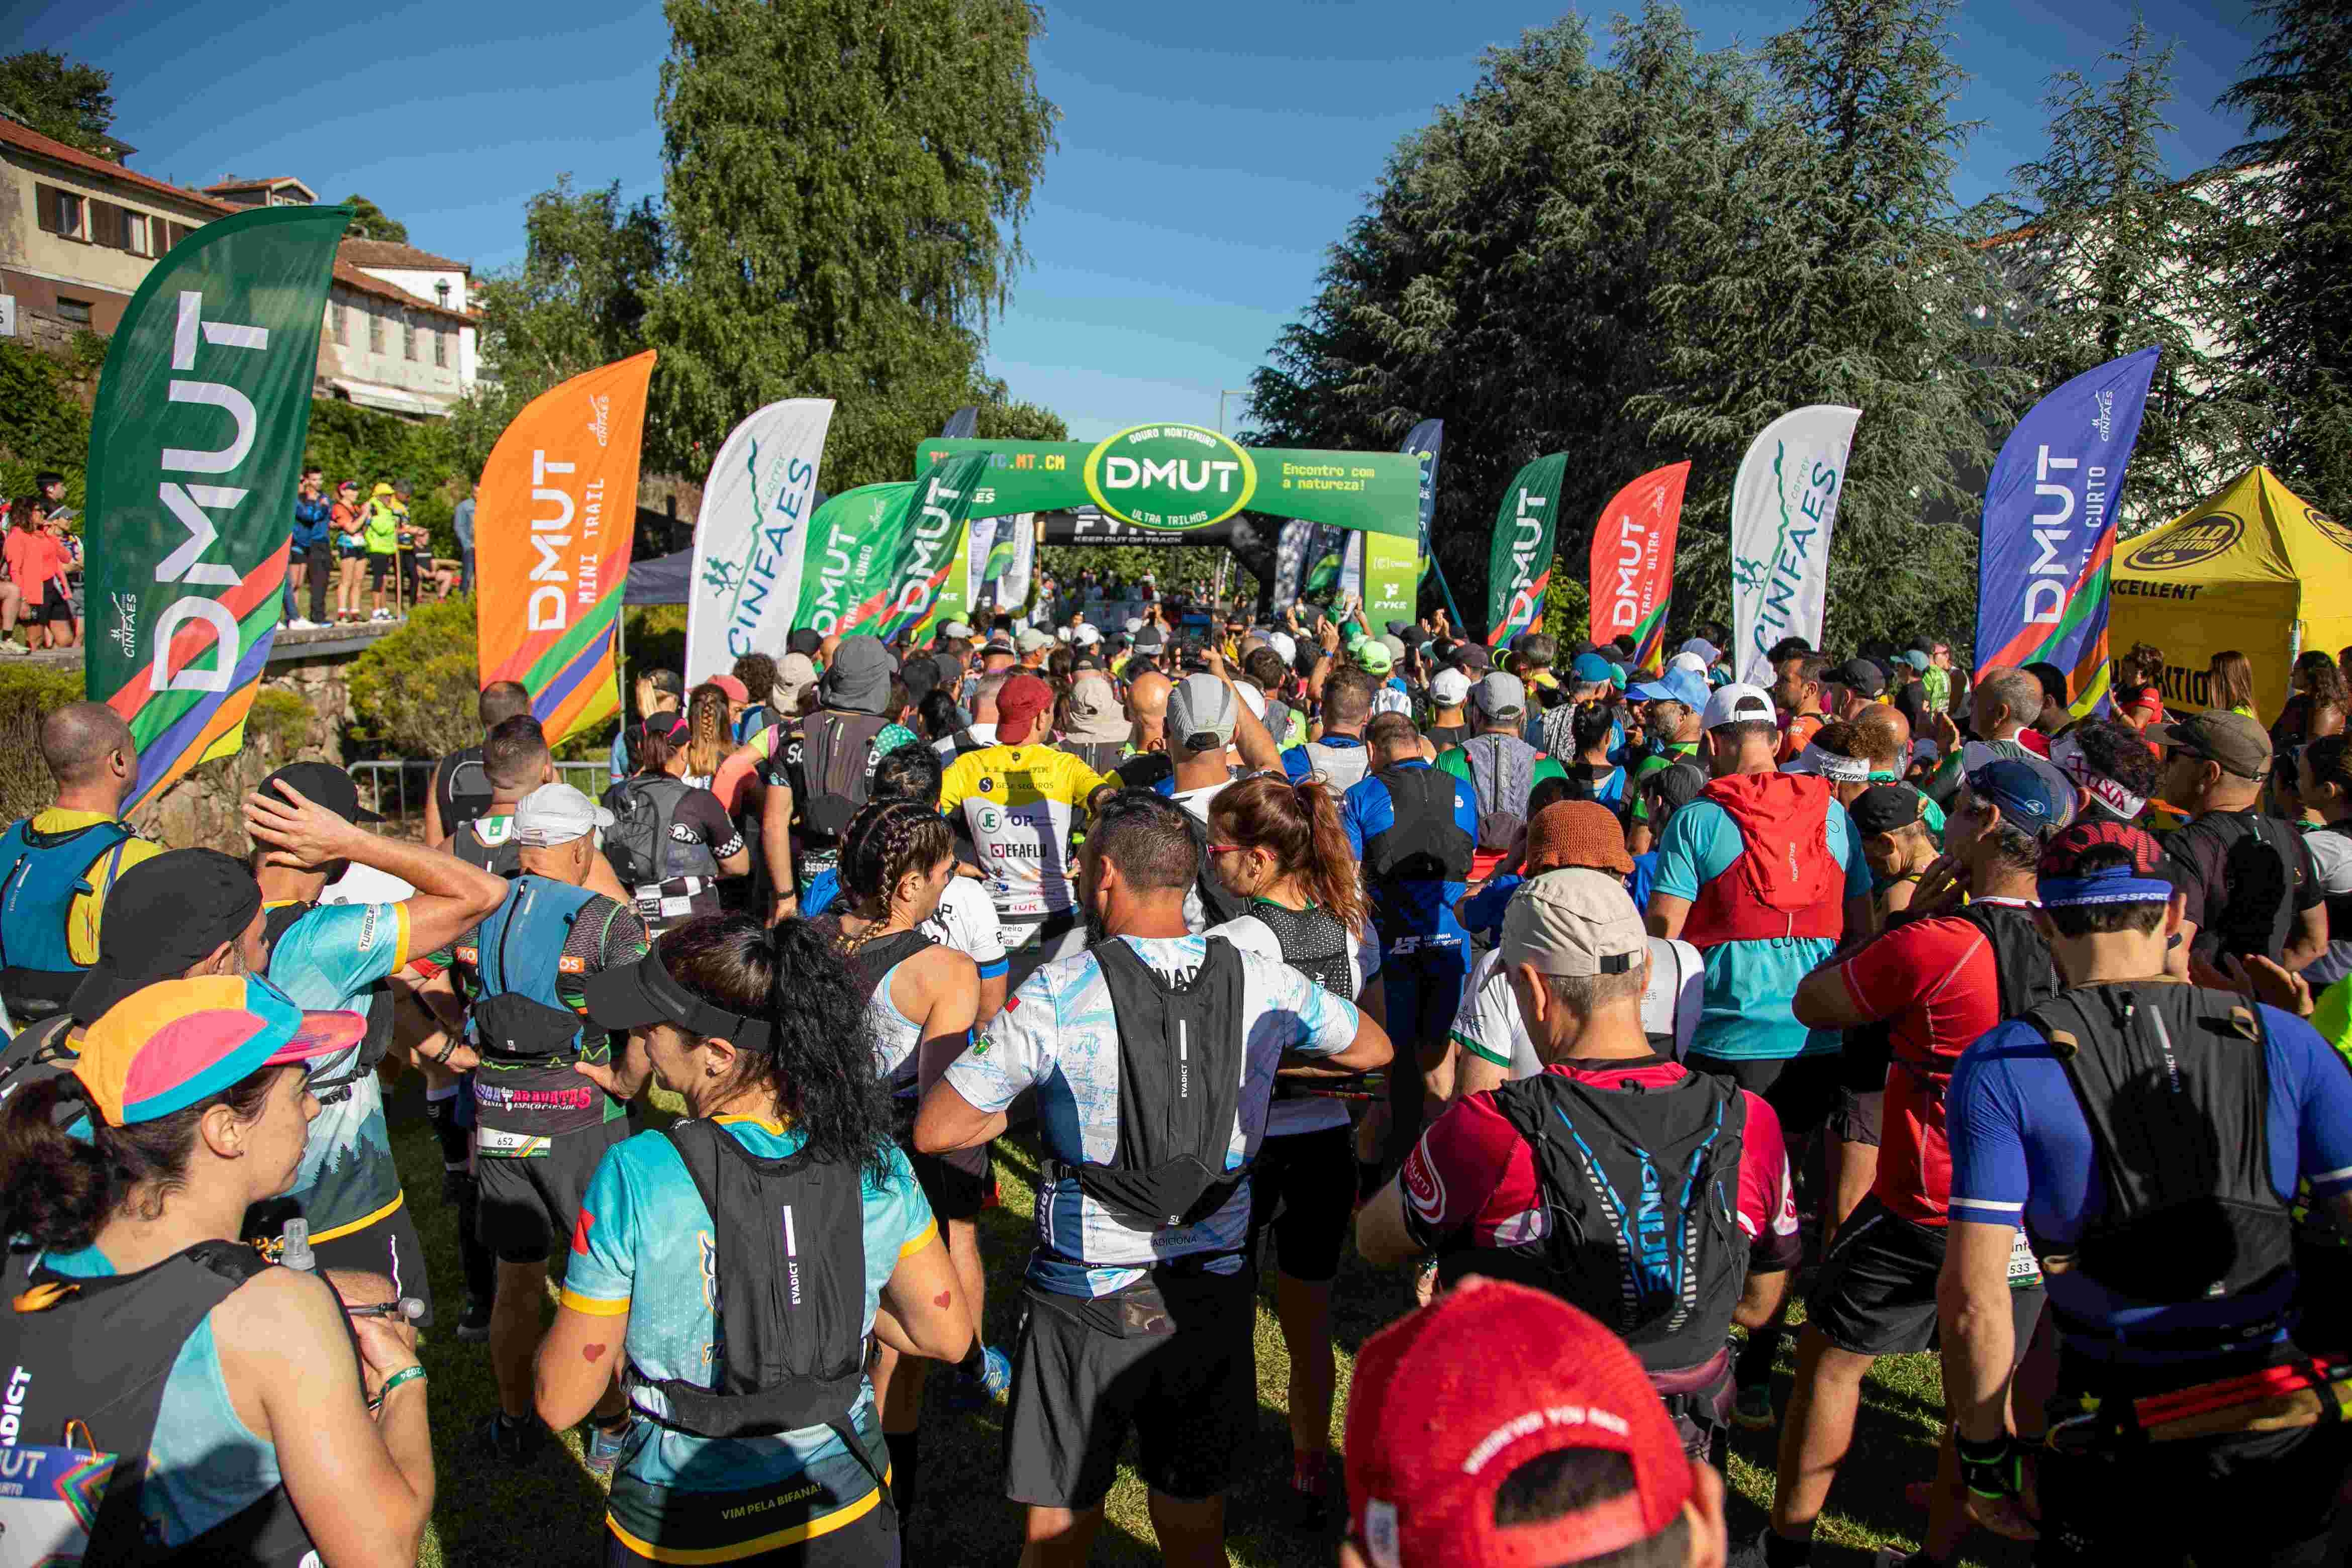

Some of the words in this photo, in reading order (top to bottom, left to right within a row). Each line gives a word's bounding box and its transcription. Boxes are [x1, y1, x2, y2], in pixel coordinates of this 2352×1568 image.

[1129, 428, 1158, 444] DOURO
[1164, 427, 1217, 448] MONTEMURO
[149, 290, 269, 693] DMUT
[1106, 456, 1239, 493] DMUT
[1282, 478, 1291, 489] a
[1298, 478, 1365, 491] natureza!
[1283, 462, 1344, 477] Encontro
[1351, 466, 1376, 478] com
[2086, 466, 2106, 528] CURTO
[584, 478, 605, 539] TRAIL
[1132, 509, 1161, 525] ULTRA
[1167, 510, 1207, 526] TRILHOS
[2023, 445, 2078, 624] DMUT
[528, 449, 575, 631] DMUT
[728, 458, 812, 658] CINFAES
[898, 477, 960, 613] DMUT
[1507, 487, 1546, 625] DMUT
[1753, 461, 1836, 655] CINFAES
[578, 553, 598, 604] MINI
[811, 524, 857, 638] DMUT
[1612, 515, 1645, 628] DMUT
[1640, 579, 1654, 616] TRAIL
[1647, 531, 1660, 570] ULTRA
[2110, 579, 2204, 601] XCELLENT
[124, 594, 137, 657] CINFAES
[2050, 893, 2169, 907] COMPRESSPORT
[497, 1137, 513, 1146] 652
[789, 1261, 801, 1305] EVADICT
[2010, 1262, 2030, 1274] 533
[721, 1506, 745, 1520] VIM
[747, 1499, 775, 1515] PELA
